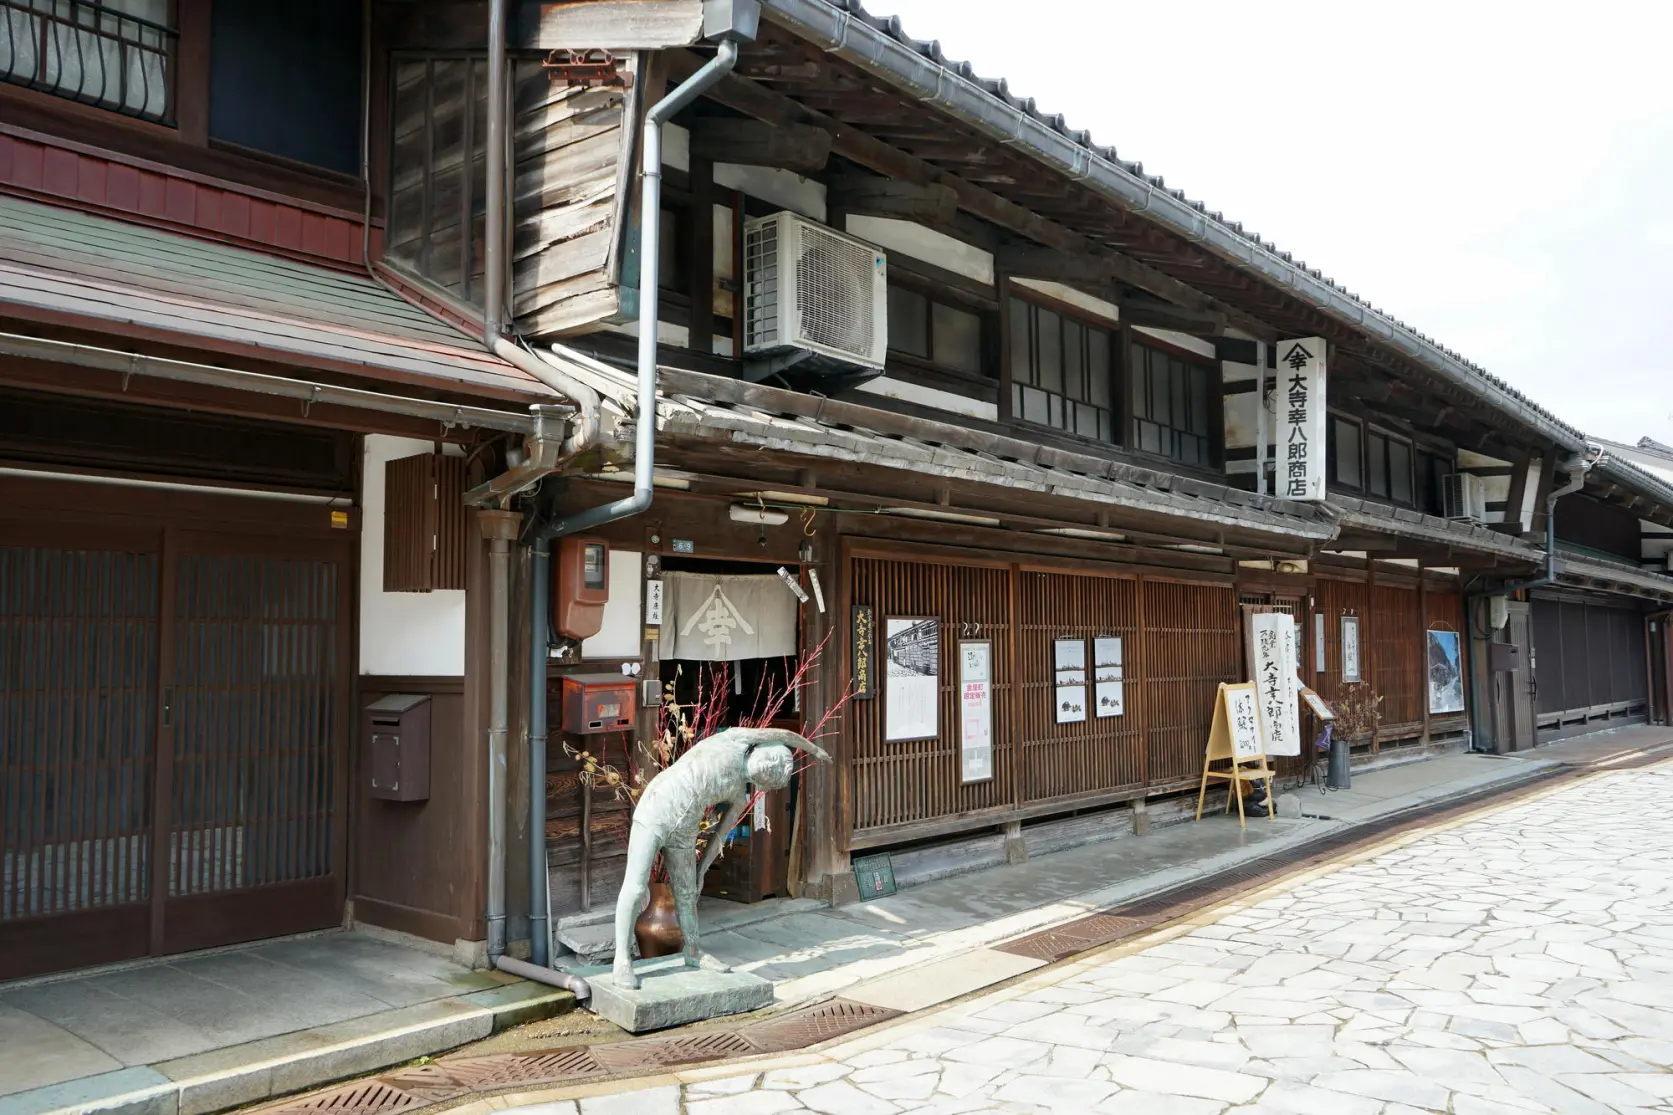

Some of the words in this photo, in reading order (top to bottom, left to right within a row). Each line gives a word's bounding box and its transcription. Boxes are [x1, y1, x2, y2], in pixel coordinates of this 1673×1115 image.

[1287, 373, 1308, 496] 大寺幸八郎商店
